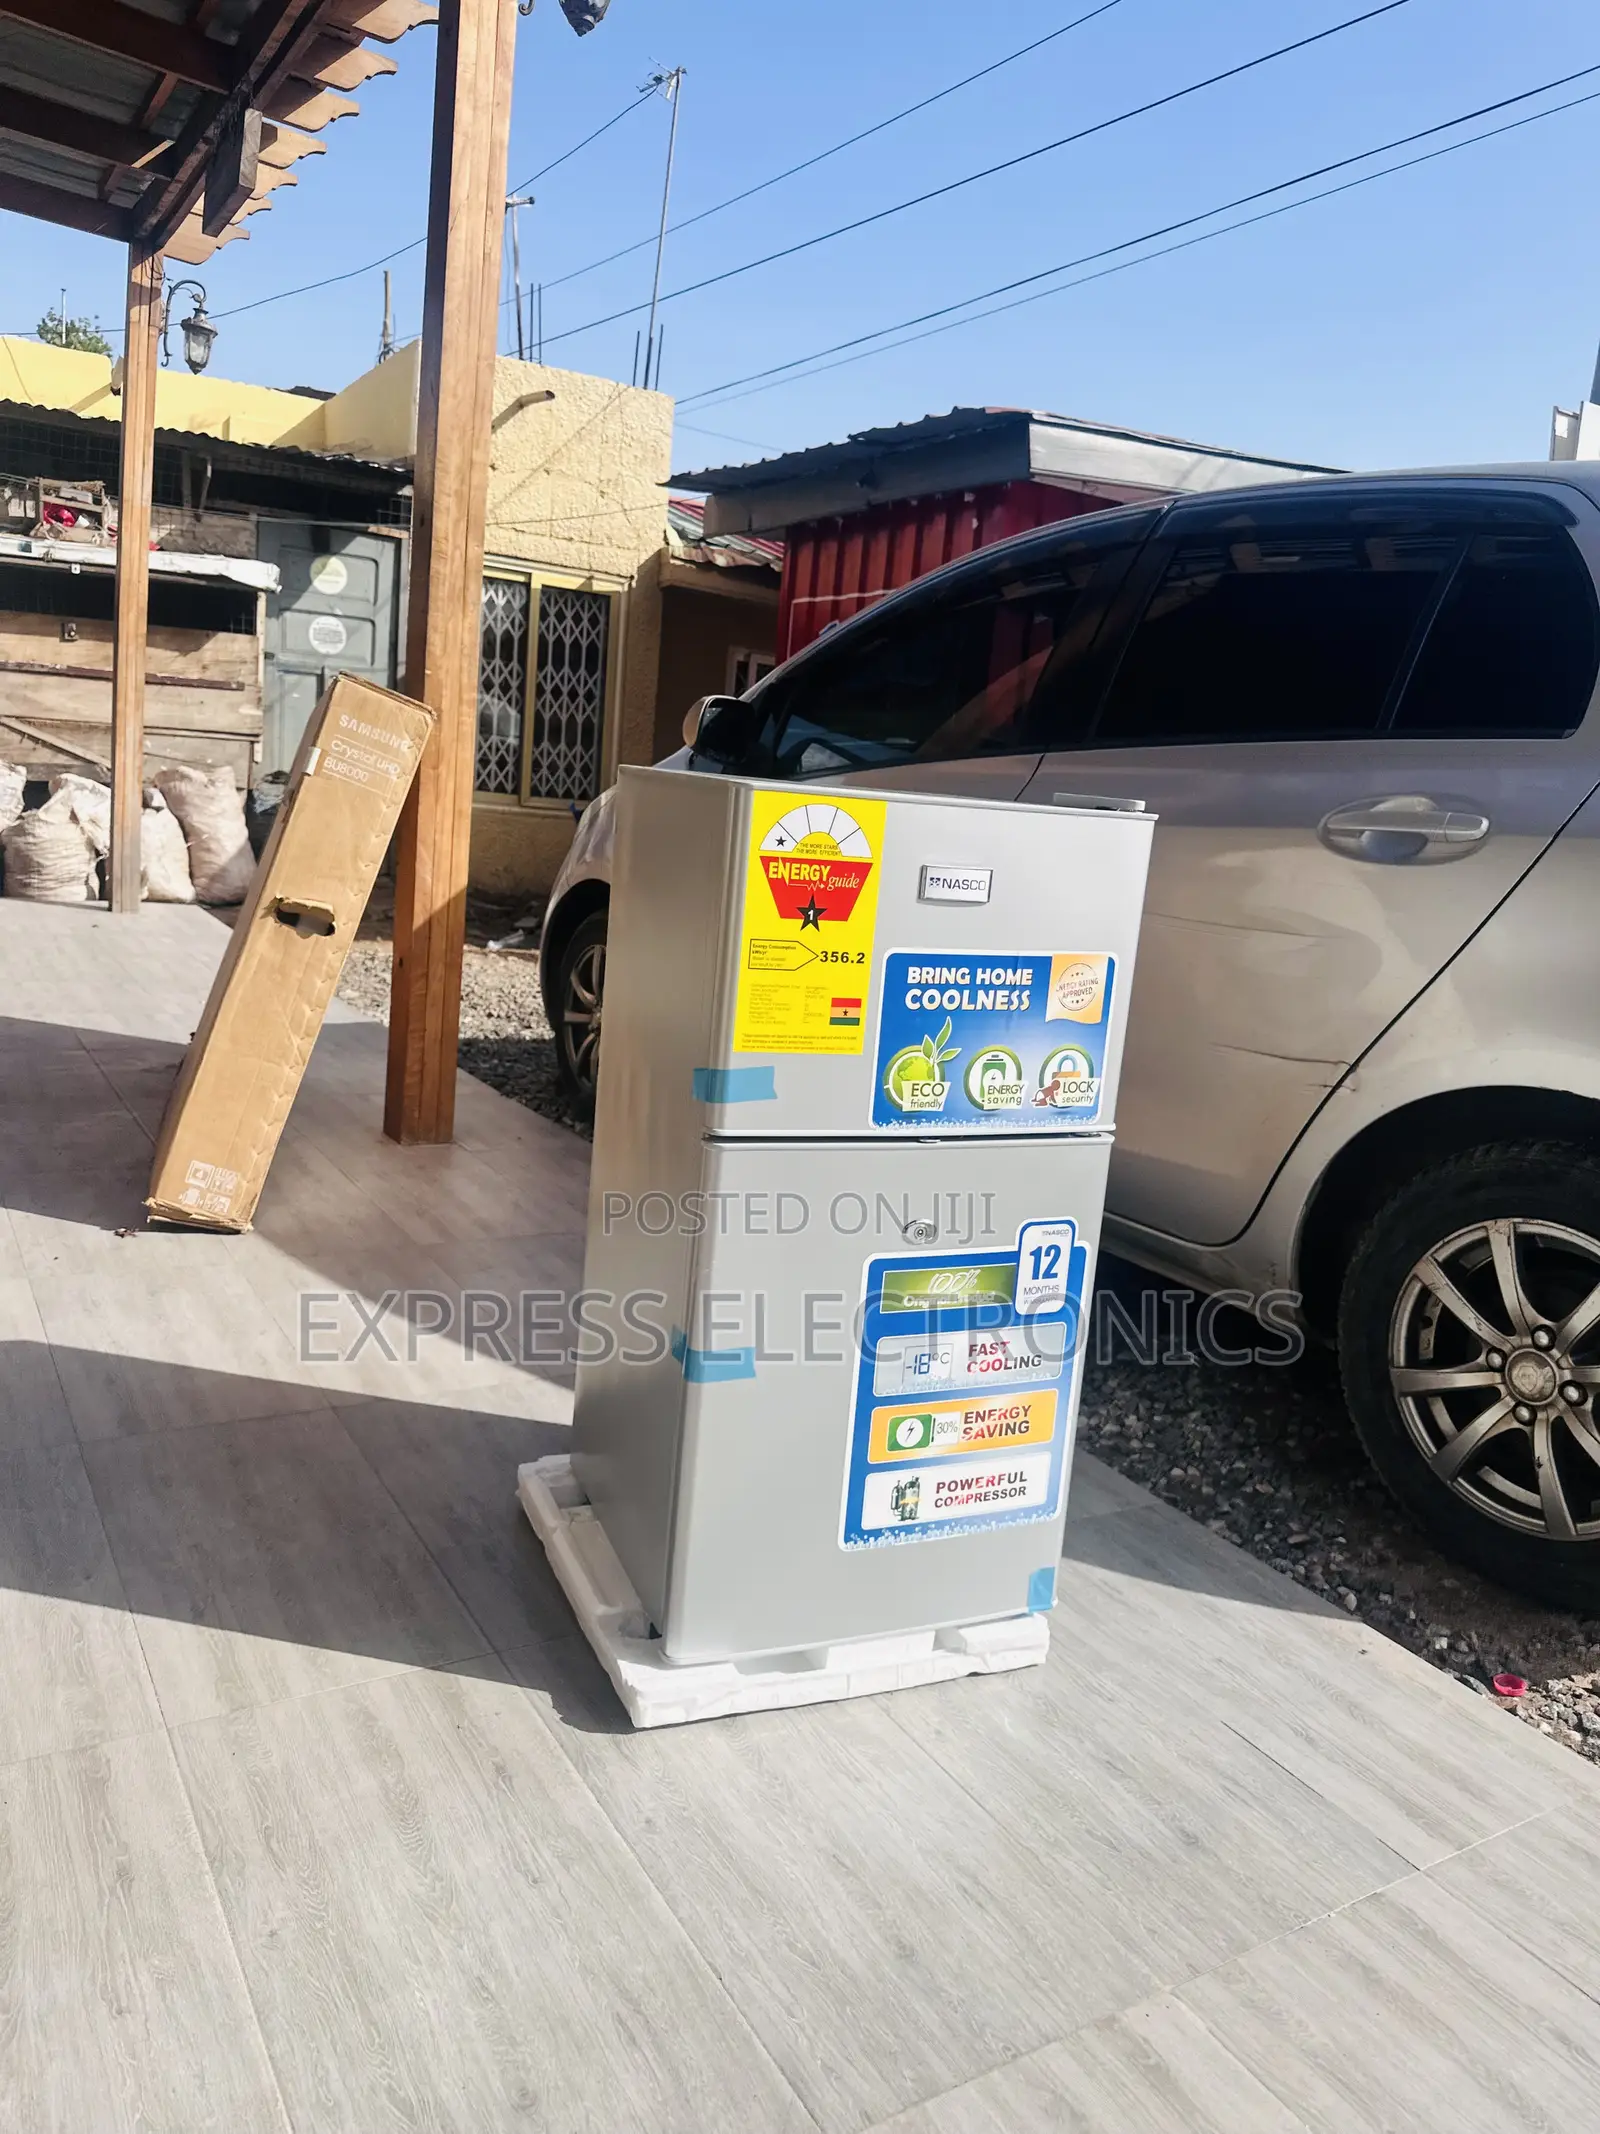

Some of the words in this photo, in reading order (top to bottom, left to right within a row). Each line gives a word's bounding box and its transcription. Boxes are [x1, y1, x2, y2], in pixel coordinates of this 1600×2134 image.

[339, 714, 410, 752] SAMSUNG
[331, 740, 376, 763] Crystal
[377, 758, 400, 774] UHD
[323, 756, 369, 782] BU8000
[768, 857, 831, 886] ENERGY
[826, 873, 860, 891] guide
[942, 878, 986, 891] NASCO
[807, 909, 814, 920] 1
[820, 951, 865, 964] 356.2
[907, 966, 970, 985] BRING
[976, 967, 1033, 986] HOME
[905, 989, 1030, 1012] COOLNESS
[911, 1081, 945, 1097] ECO
[987, 1084, 1024, 1095] ENERGY
[1062, 1080, 1095, 1093] LOCK
[910, 1099, 943, 1109] friendly
[987, 1095, 1022, 1105] saving
[1062, 1094, 1094, 1104] security
[1029, 1244, 1061, 1280] 12
[928, 1269, 981, 1293] 100%
[1023, 1285, 1060, 1296] MONTHS
[968, 1341, 1010, 1358] FAST
[967, 1354, 1042, 1373] COOLING
[963, 1405, 1032, 1425] ENERGY
[936, 1421, 958, 1434] 30%
[961, 1420, 1030, 1441] SAVING
[935, 1471, 1028, 1495] POWERFUL
[934, 1486, 1026, 1508] COMPRESSOR
